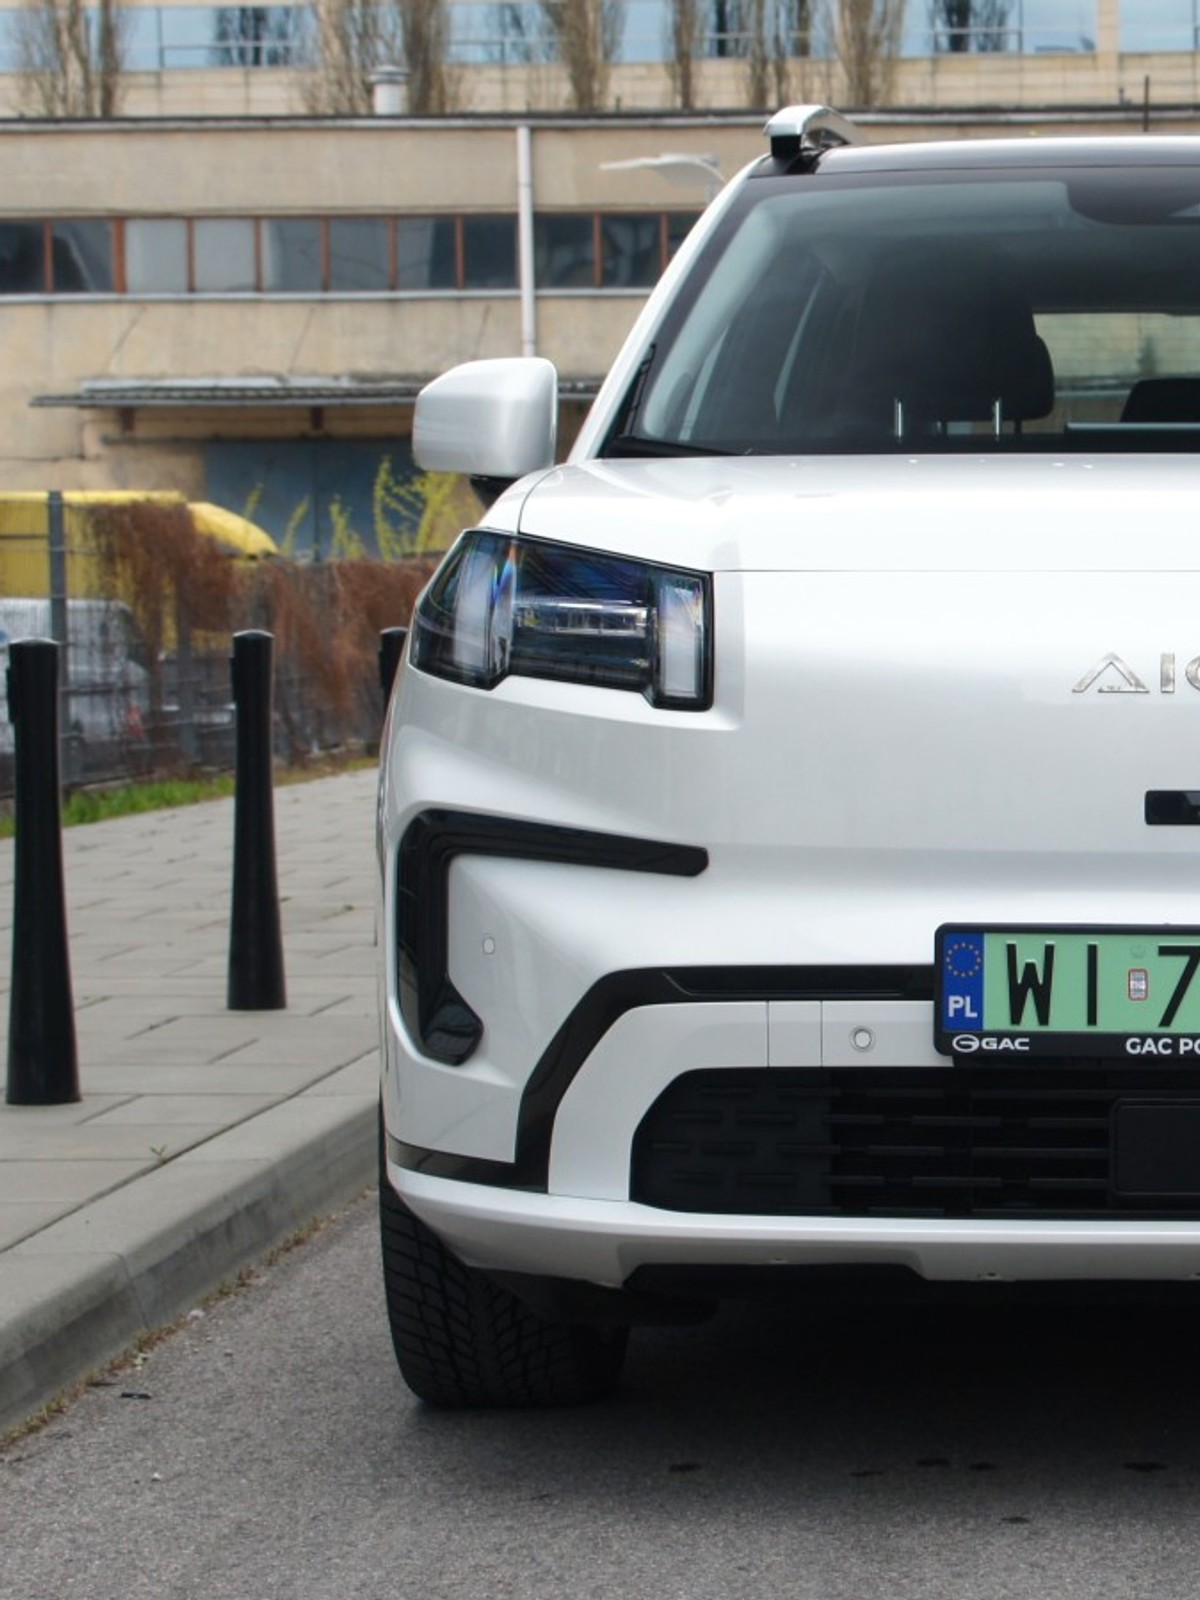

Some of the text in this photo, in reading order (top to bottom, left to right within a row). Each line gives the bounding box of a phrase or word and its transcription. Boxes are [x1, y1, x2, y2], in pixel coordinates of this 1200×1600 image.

[1006, 942, 1098, 1027] WI
[948, 995, 978, 1018] PL
[981, 1037, 1030, 1050] GAC
[1125, 1037, 1173, 1055] GAC
